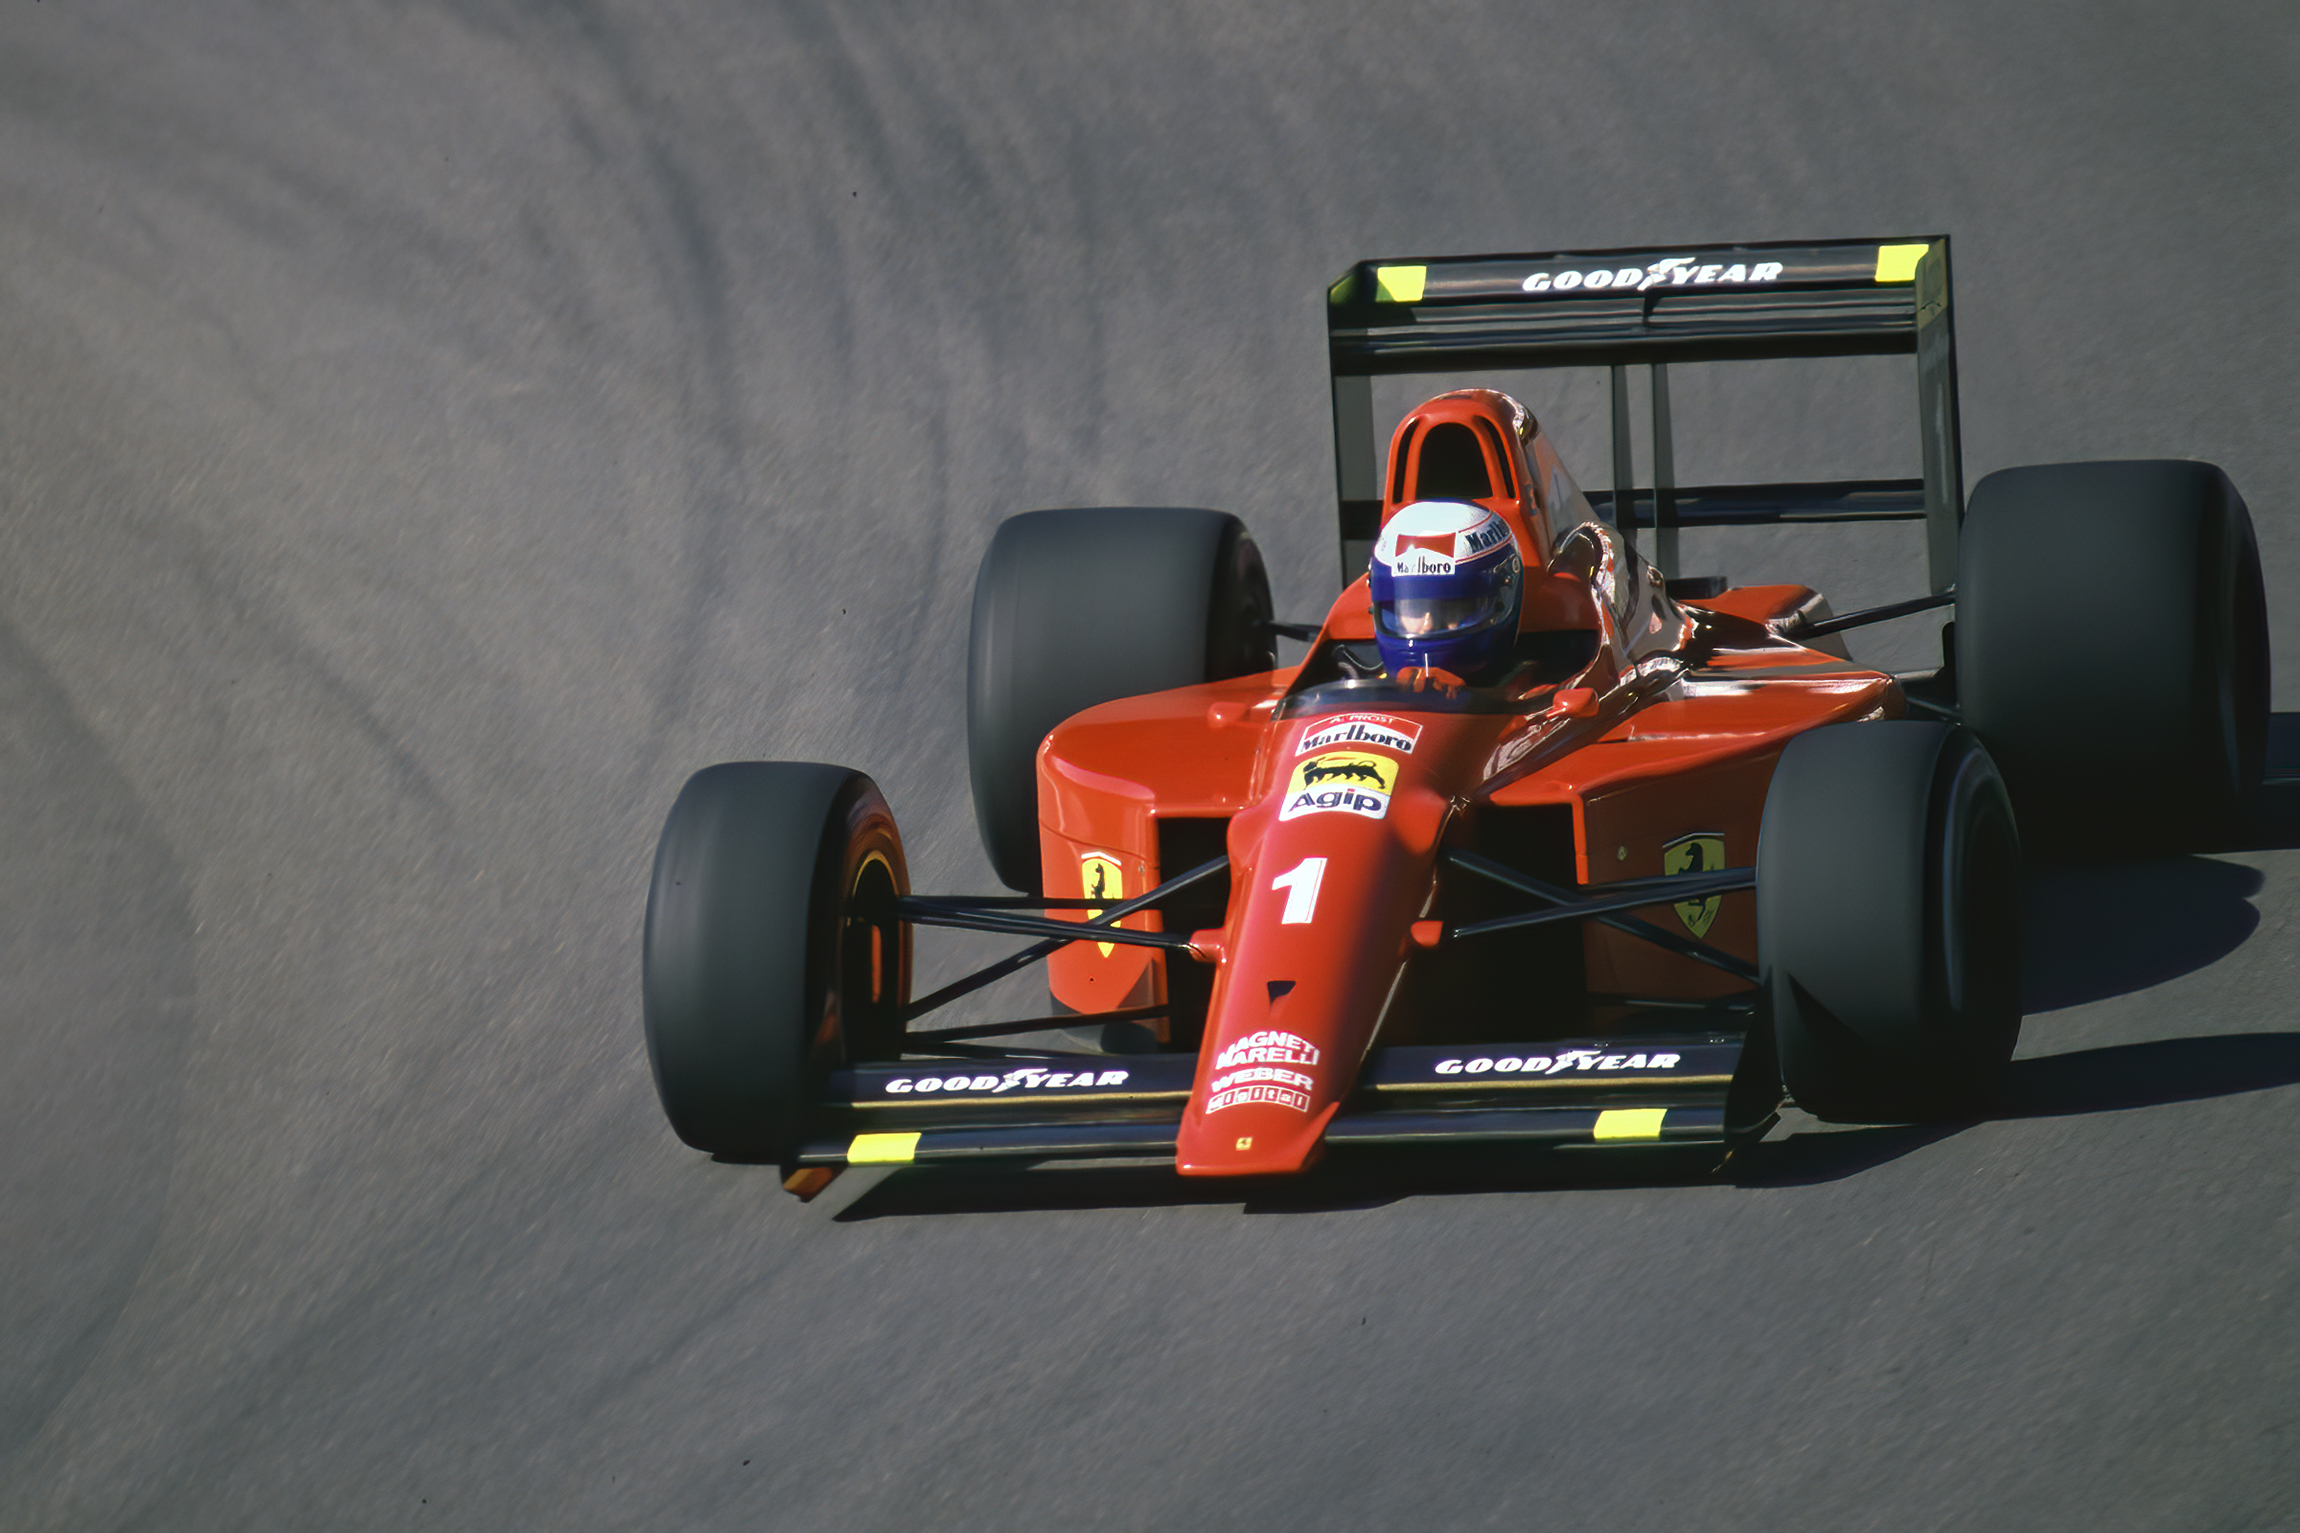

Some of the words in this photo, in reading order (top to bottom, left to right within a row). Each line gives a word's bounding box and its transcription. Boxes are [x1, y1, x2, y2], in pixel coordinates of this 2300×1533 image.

[1522, 258, 1784, 291] GOODYEAR
[1349, 714, 1394, 726] PROST
[1301, 723, 1412, 753] Marlboro
[1287, 788, 1382, 812] Agip
[1271, 857, 1328, 925] 1
[1435, 1051, 1681, 1075] GOODYEAR
[885, 1068, 1130, 1094] GOODYEAR
[1211, 1066, 1314, 1092] WEBER
